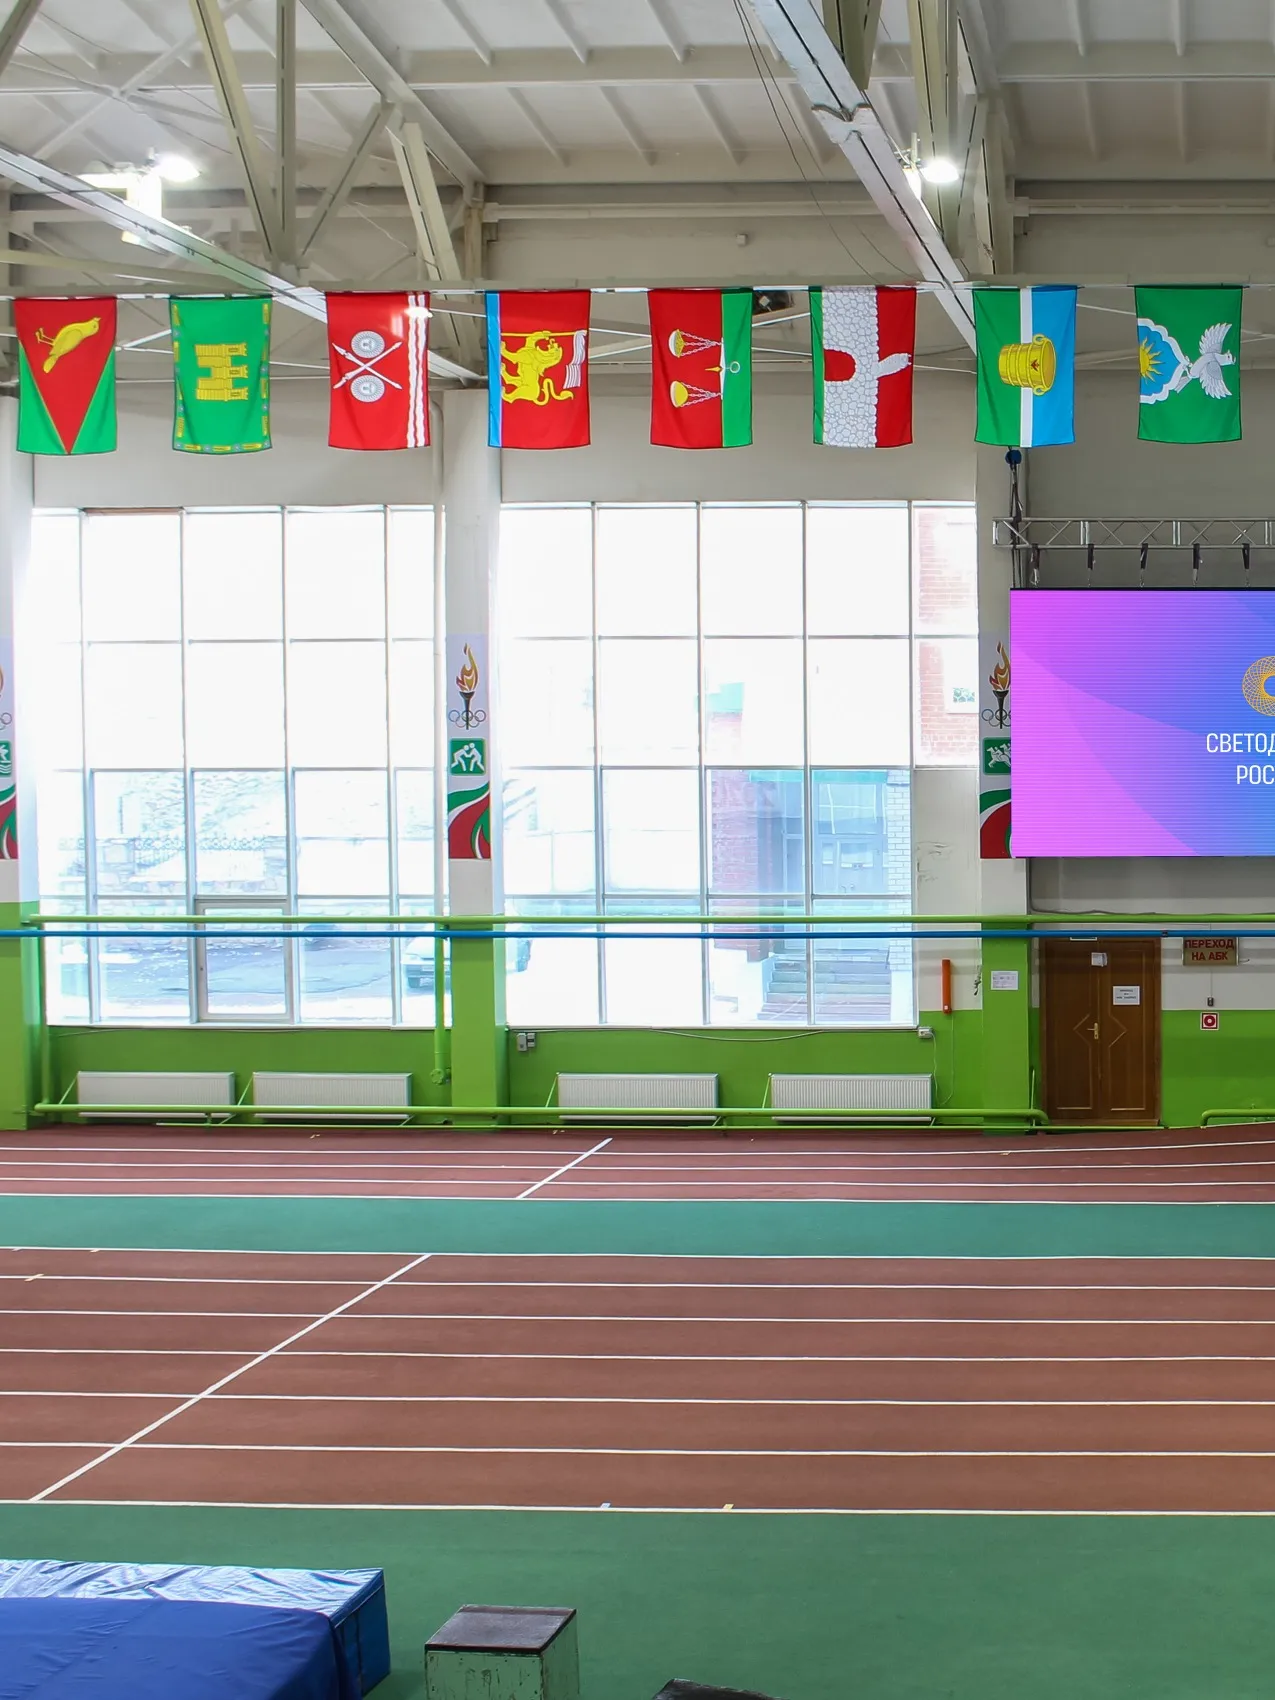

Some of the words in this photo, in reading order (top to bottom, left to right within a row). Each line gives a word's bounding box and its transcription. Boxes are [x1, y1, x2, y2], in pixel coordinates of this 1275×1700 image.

[1184, 939, 1235, 950] ПЕРЕХОД
[1192, 951, 1207, 961] НА
[1208, 951, 1229, 961] АБК
